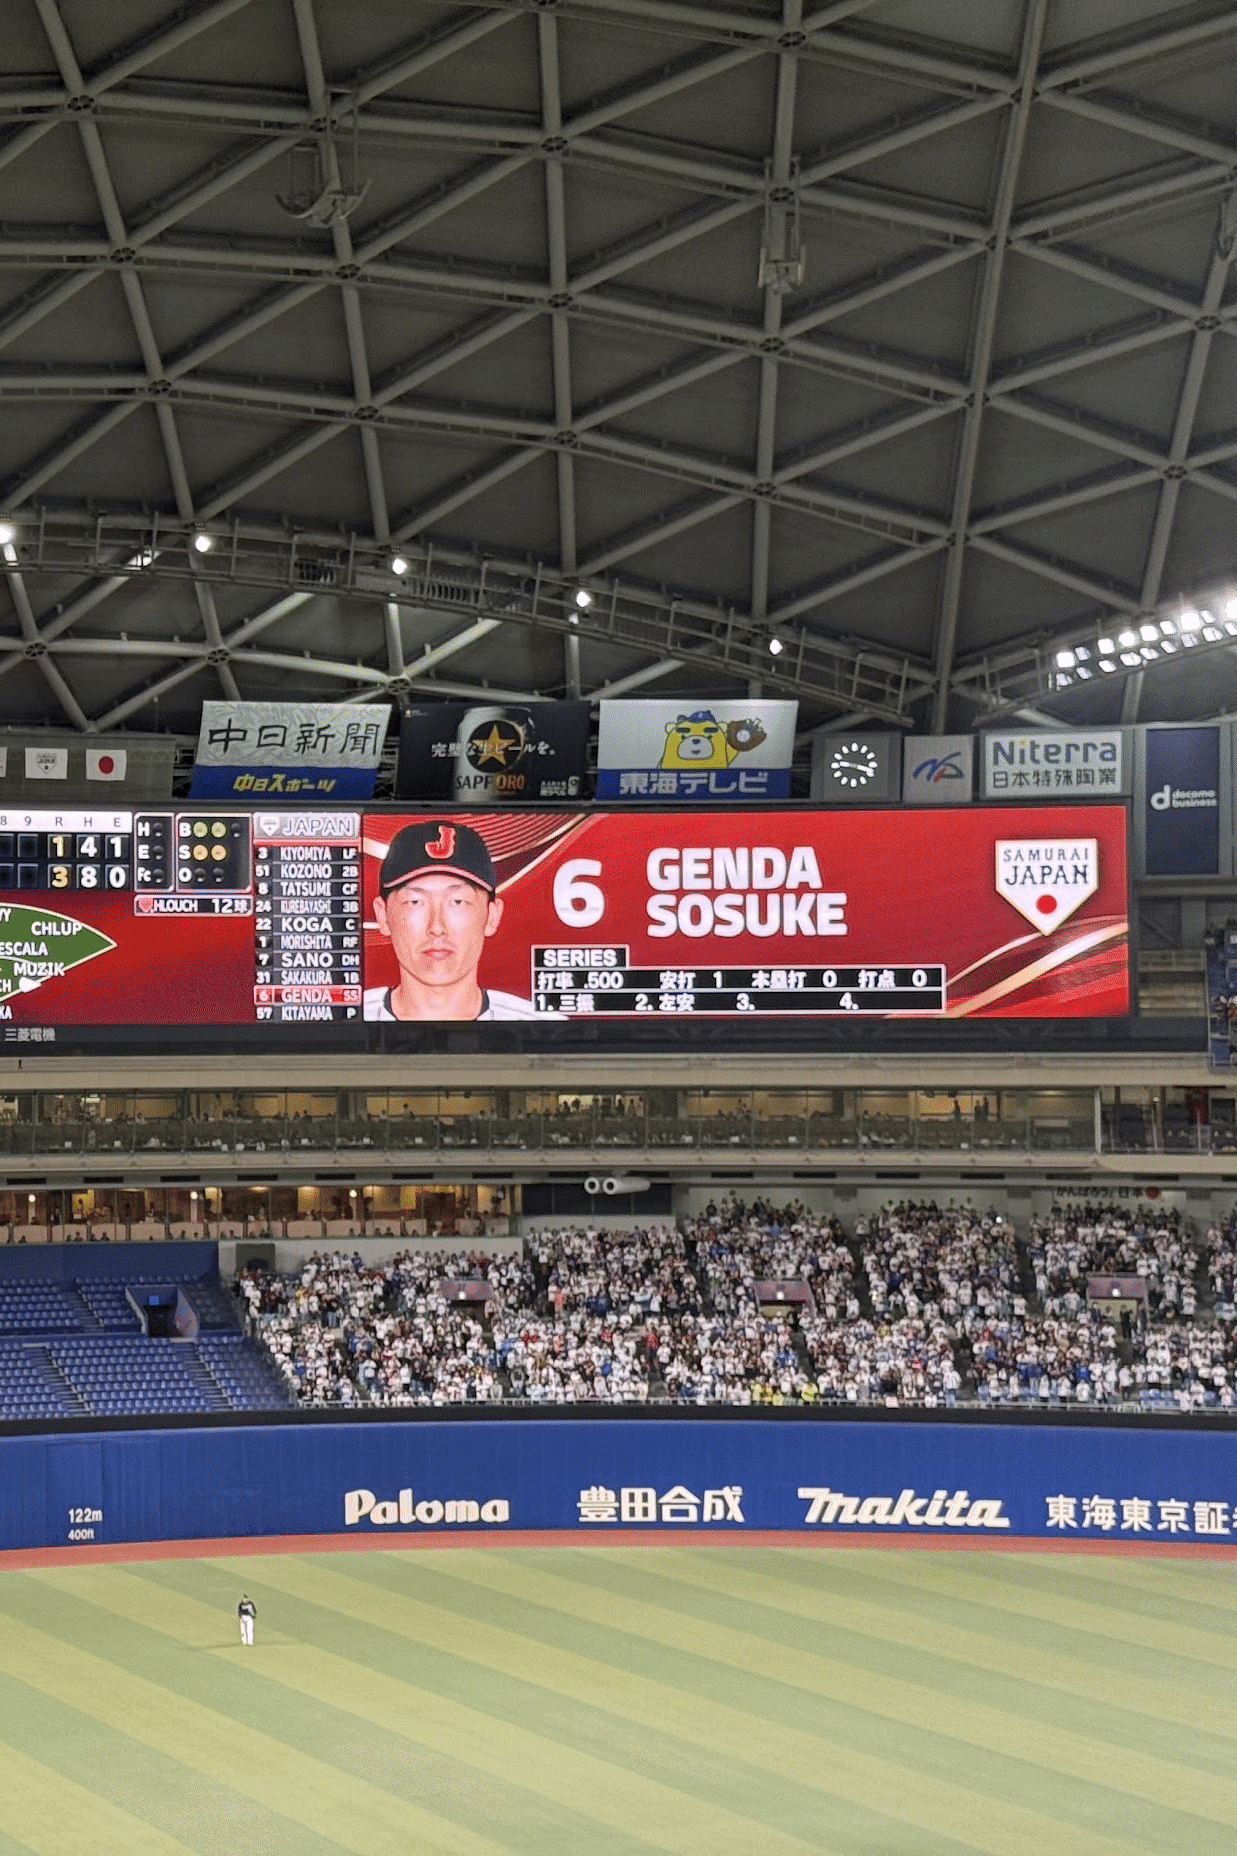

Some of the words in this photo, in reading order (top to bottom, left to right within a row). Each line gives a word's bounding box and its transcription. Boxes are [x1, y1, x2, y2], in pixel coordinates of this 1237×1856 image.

[208, 718, 380, 756] 中日新聞
[992, 740, 1117, 767] Niterra
[233, 773, 337, 793] 中日スポーツ
[619, 771, 769, 795] 東海テレビ
[992, 768, 1117, 788] 日本特殊陶業
[1172, 798, 1217, 809] business
[137, 821, 150, 837] H
[179, 822, 192, 837] B
[282, 816, 353, 836] JAPAN
[52, 836, 64, 857] 1
[80, 836, 97, 857] 4
[110, 836, 122, 857] 1
[137, 844, 150, 860] E
[178, 844, 191, 860] S
[281, 846, 332, 861] KIYOMIYA
[342, 848, 357, 859] LF
[1002, 847, 1089, 862] SAMURAI
[178, 867, 192, 882] O
[255, 865, 270, 877] 51
[281, 863, 332, 878] KOZONO
[342, 866, 359, 877] 2B
[646, 846, 823, 891] GENDA
[1005, 864, 1089, 886] JAPAN
[52, 867, 68, 888] 3
[80, 867, 98, 888] 8
[109, 867, 126, 888] 0
[281, 882, 332, 896] TATSUMI
[342, 884, 358, 895] CF
[553, 858, 605, 928] 6
[153, 899, 198, 912] HLOUCH
[255, 901, 272, 913] 24
[342, 901, 359, 913] 3B
[646, 892, 847, 937] SOSUKE
[31, 922, 82, 935] CHLUP
[255, 918, 272, 930] 22
[281, 917, 332, 932] KOGA
[281, 935, 332, 949] MORISHITA
[343, 937, 358, 948] RF
[281, 953, 332, 967] SANO
[342, 955, 359, 966] DH
[543, 949, 618, 967] SERIES
[13, 962, 65, 976] MUZIK
[256, 972, 271, 983] 31
[281, 971, 332, 985] SAKAKURA
[343, 972, 359, 983] 1B
[537, 971, 574, 990] 打率
[584, 971, 624, 988] .500
[659, 970, 696, 990] 安打
[713, 971, 723, 988] 1
[751, 969, 807, 989] 本塁打
[822, 970, 838, 988] 0
[858, 969, 895, 989] 打点
[912, 970, 927, 987] 0
[281, 989, 332, 1003] GENDA
[343, 990, 358, 1001] SS
[256, 1007, 273, 1019] 57
[281, 1006, 332, 1021] KITAYAMA
[344, 1488, 510, 1525] Paloma
[576, 1485, 745, 1523] 豊田合成
[68, 1507, 103, 1524] 122m
[1045, 1494, 1237, 1535] 東海東京証
[68, 1528, 95, 1541] 400ft
